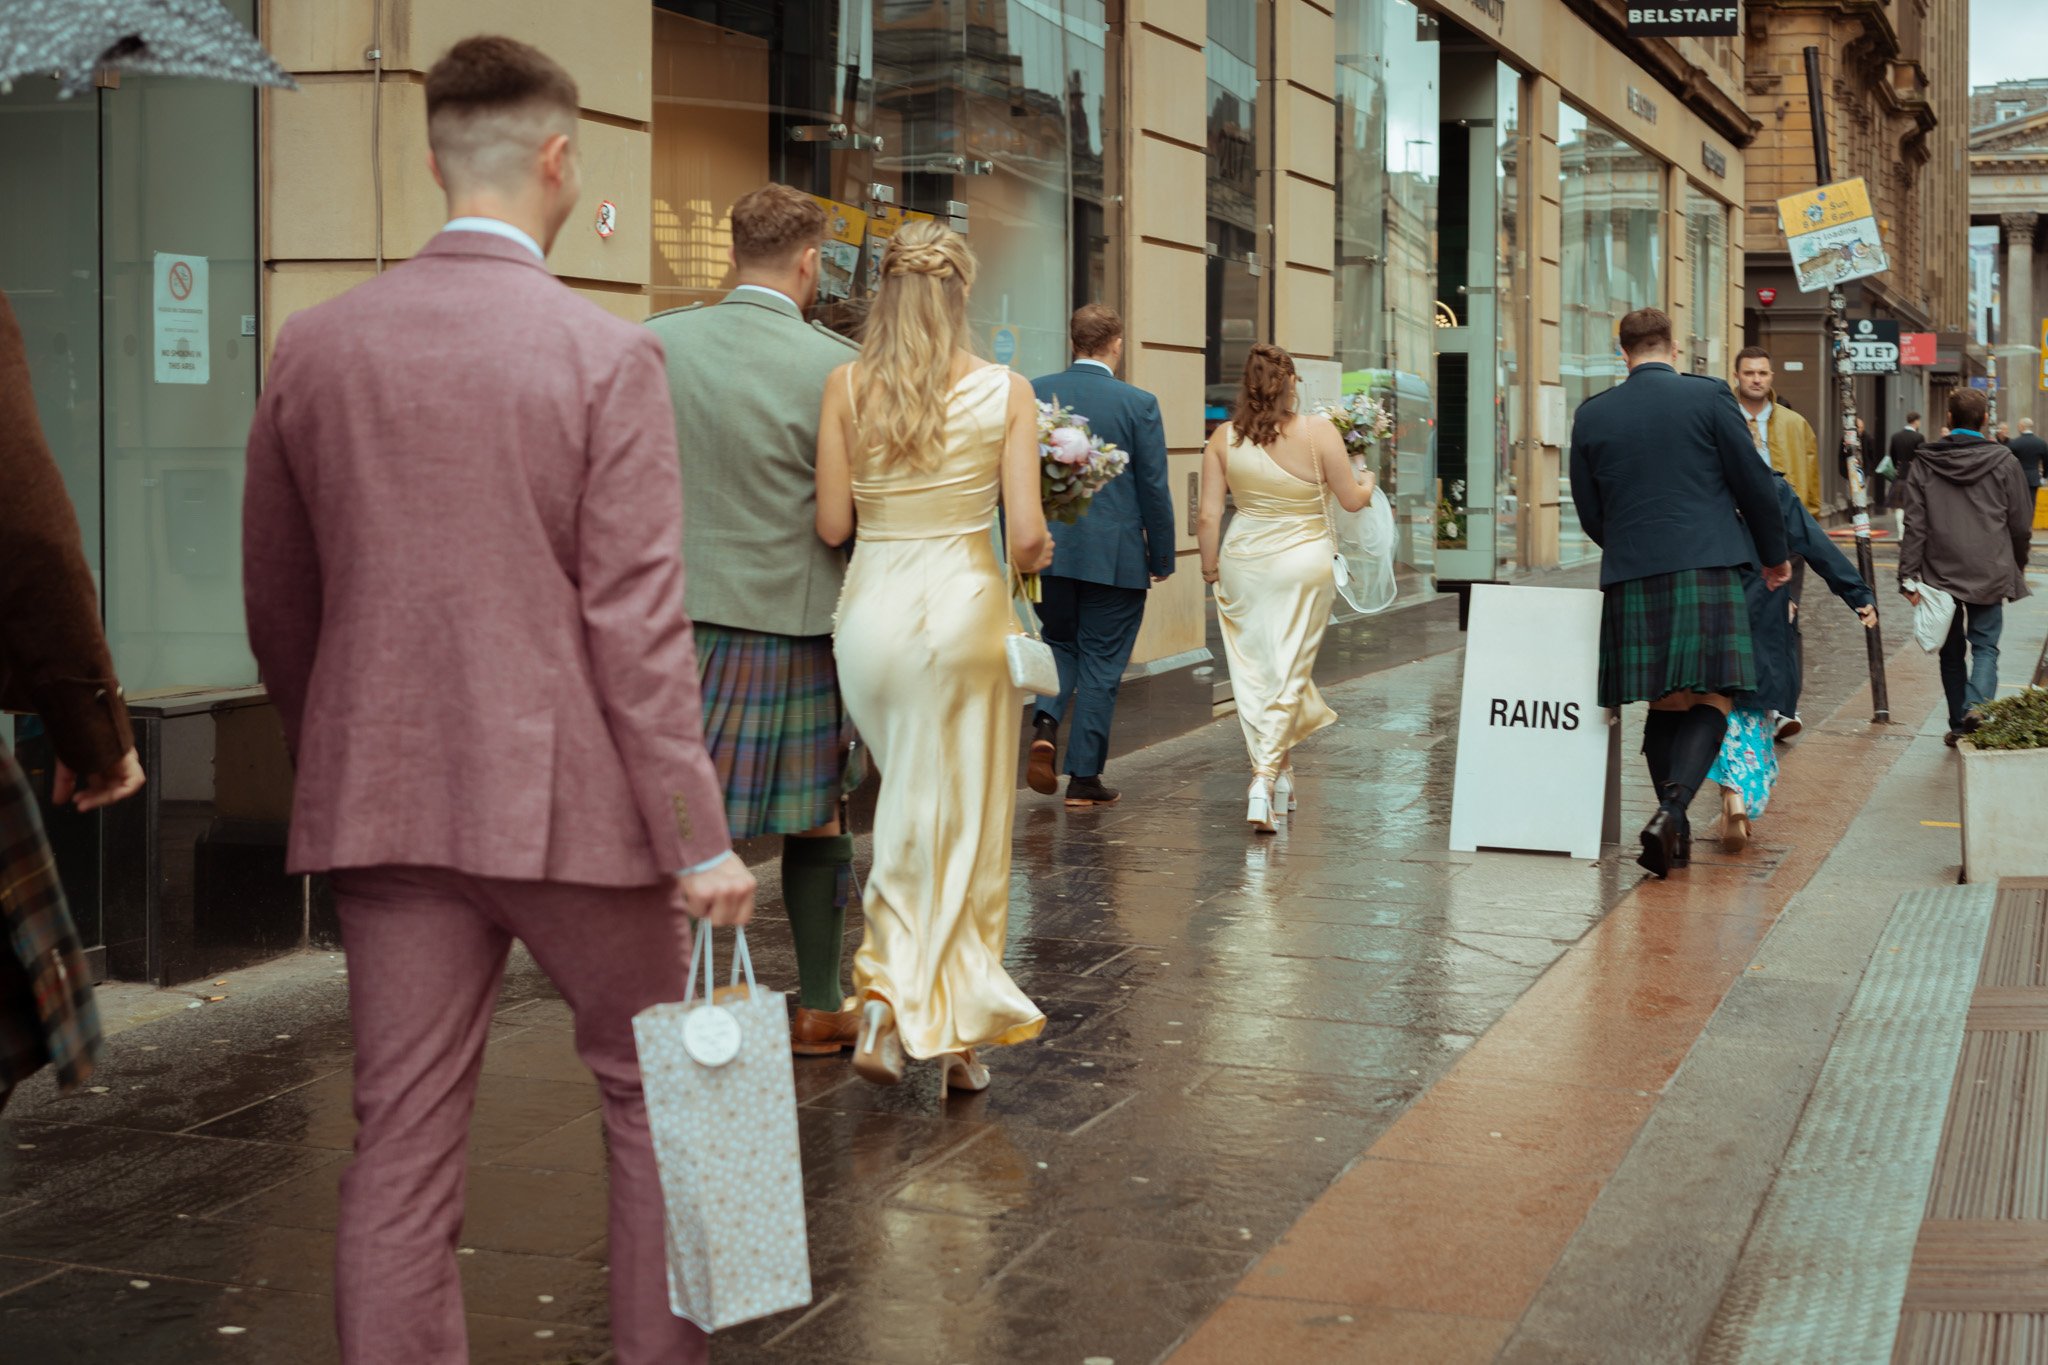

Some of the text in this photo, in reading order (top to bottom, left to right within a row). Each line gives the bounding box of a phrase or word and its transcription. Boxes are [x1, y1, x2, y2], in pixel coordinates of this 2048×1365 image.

[1628, 7, 1737, 23] BELSTAFF
[1824, 226, 1858, 240] loading
[1865, 347, 1894, 358] LET
[168, 362, 181, 370] THIS
[1489, 698, 1580, 731] RAINS
